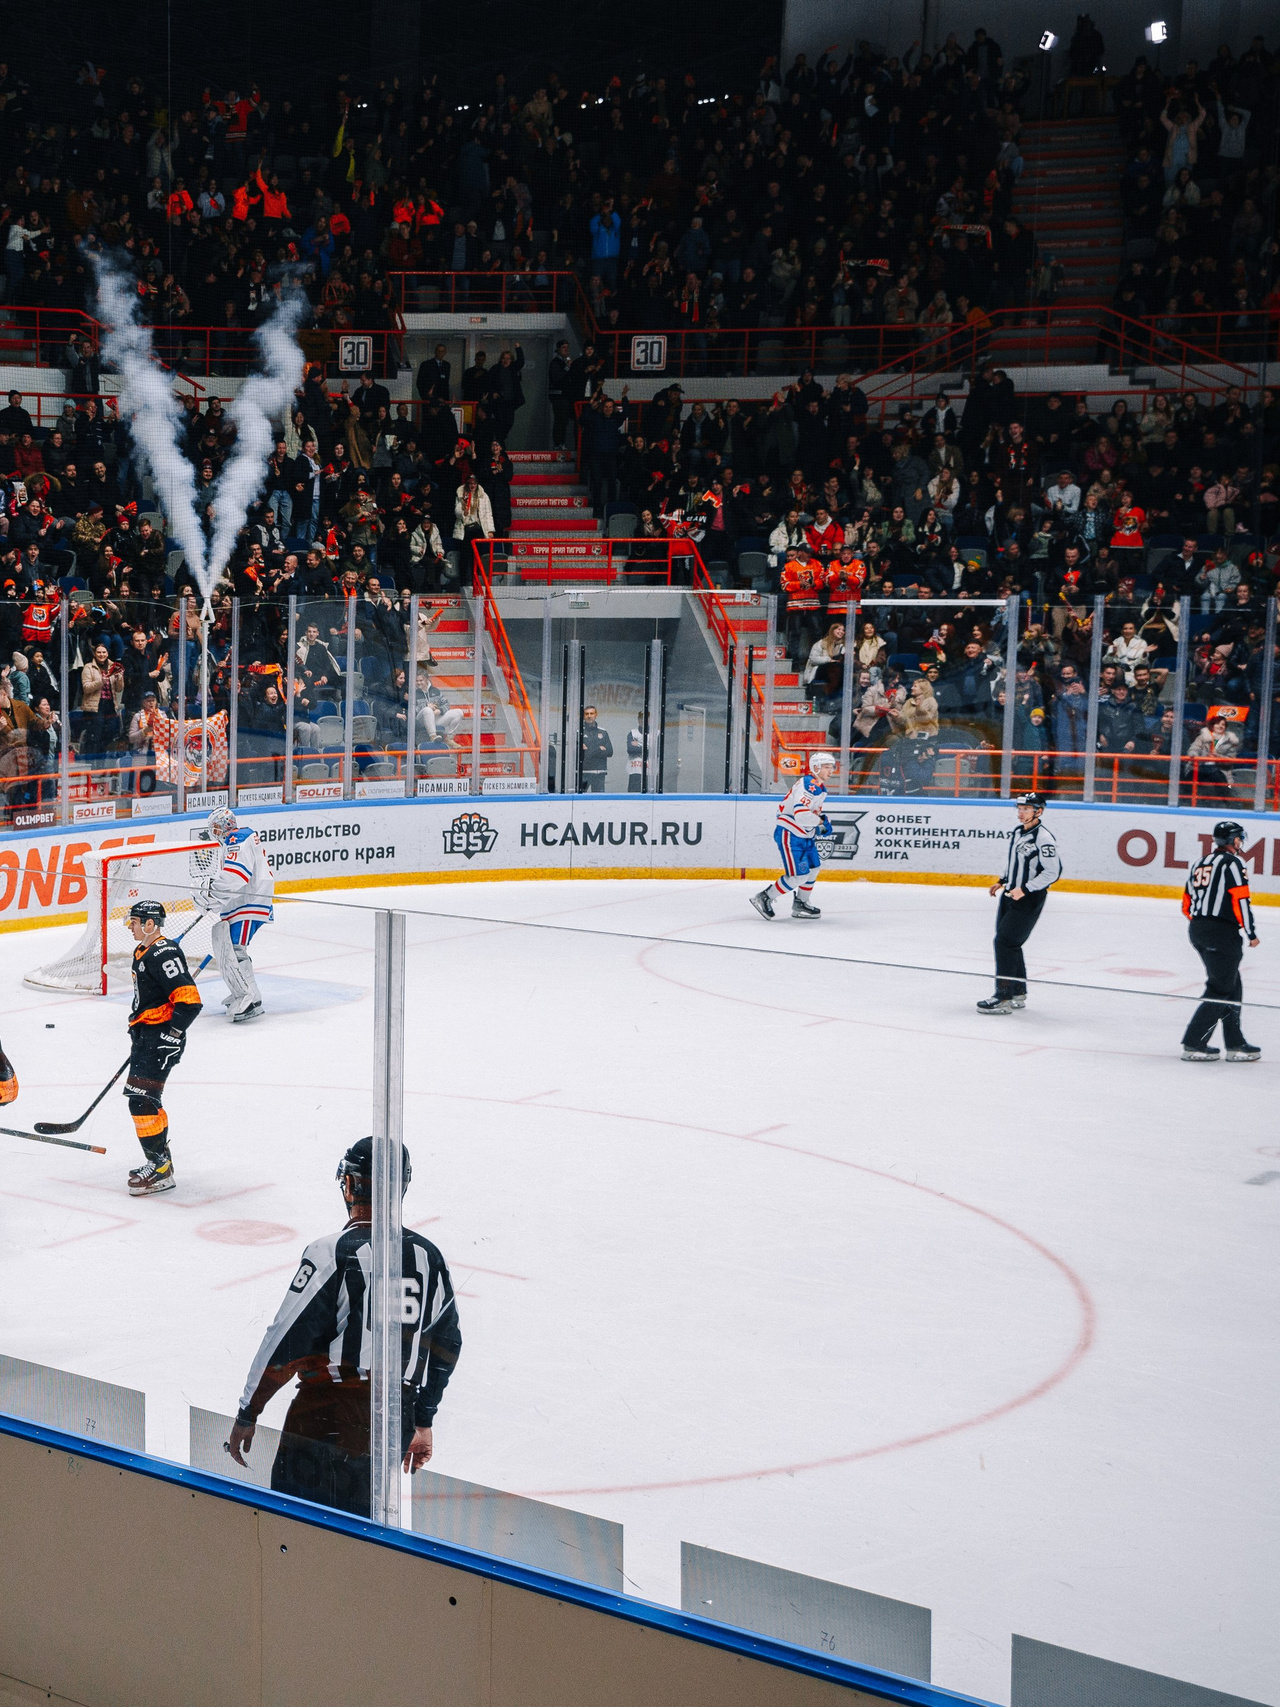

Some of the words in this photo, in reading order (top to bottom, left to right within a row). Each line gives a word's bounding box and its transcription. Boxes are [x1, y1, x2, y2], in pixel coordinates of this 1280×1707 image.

[344, 342, 368, 365] 30
[636, 341, 662, 365] 30
[533, 546, 565, 554] ТЕРРИОРИЯ
[566, 546, 587, 554] ТИГРОВ
[419, 782, 468, 793] HCAMUR.RU
[484, 782, 536, 790] TICKETS.HCAMUR.RU
[239, 790, 282, 802] TICKETS.HCAMUR.RU
[299, 787, 342, 799] SOLITE
[187, 794, 227, 808] HCAMUR.RU
[800, 797, 811, 807] 42
[76, 805, 115, 818] SOLITE
[15, 812, 55, 826] OLIMPBET
[875, 814, 931, 825] ФОНБЕТ
[521, 822, 703, 846] HCAMUR.RU
[875, 827, 1014, 840] КОНТИНЕНТАЛЬНАЯ
[445, 831, 498, 852] 1957
[875, 838, 960, 850] ХОККЕЙНАЯ
[874, 851, 909, 860] ЛИГА
[1041, 846, 1055, 857] 55
[267, 851, 349, 872] аровского
[355, 846, 395, 865] края
[1193, 866, 1212, 887] 35
[162, 957, 185, 979] 81
[293, 1264, 312, 1289] 6
[821, 1630, 835, 1650] 76
